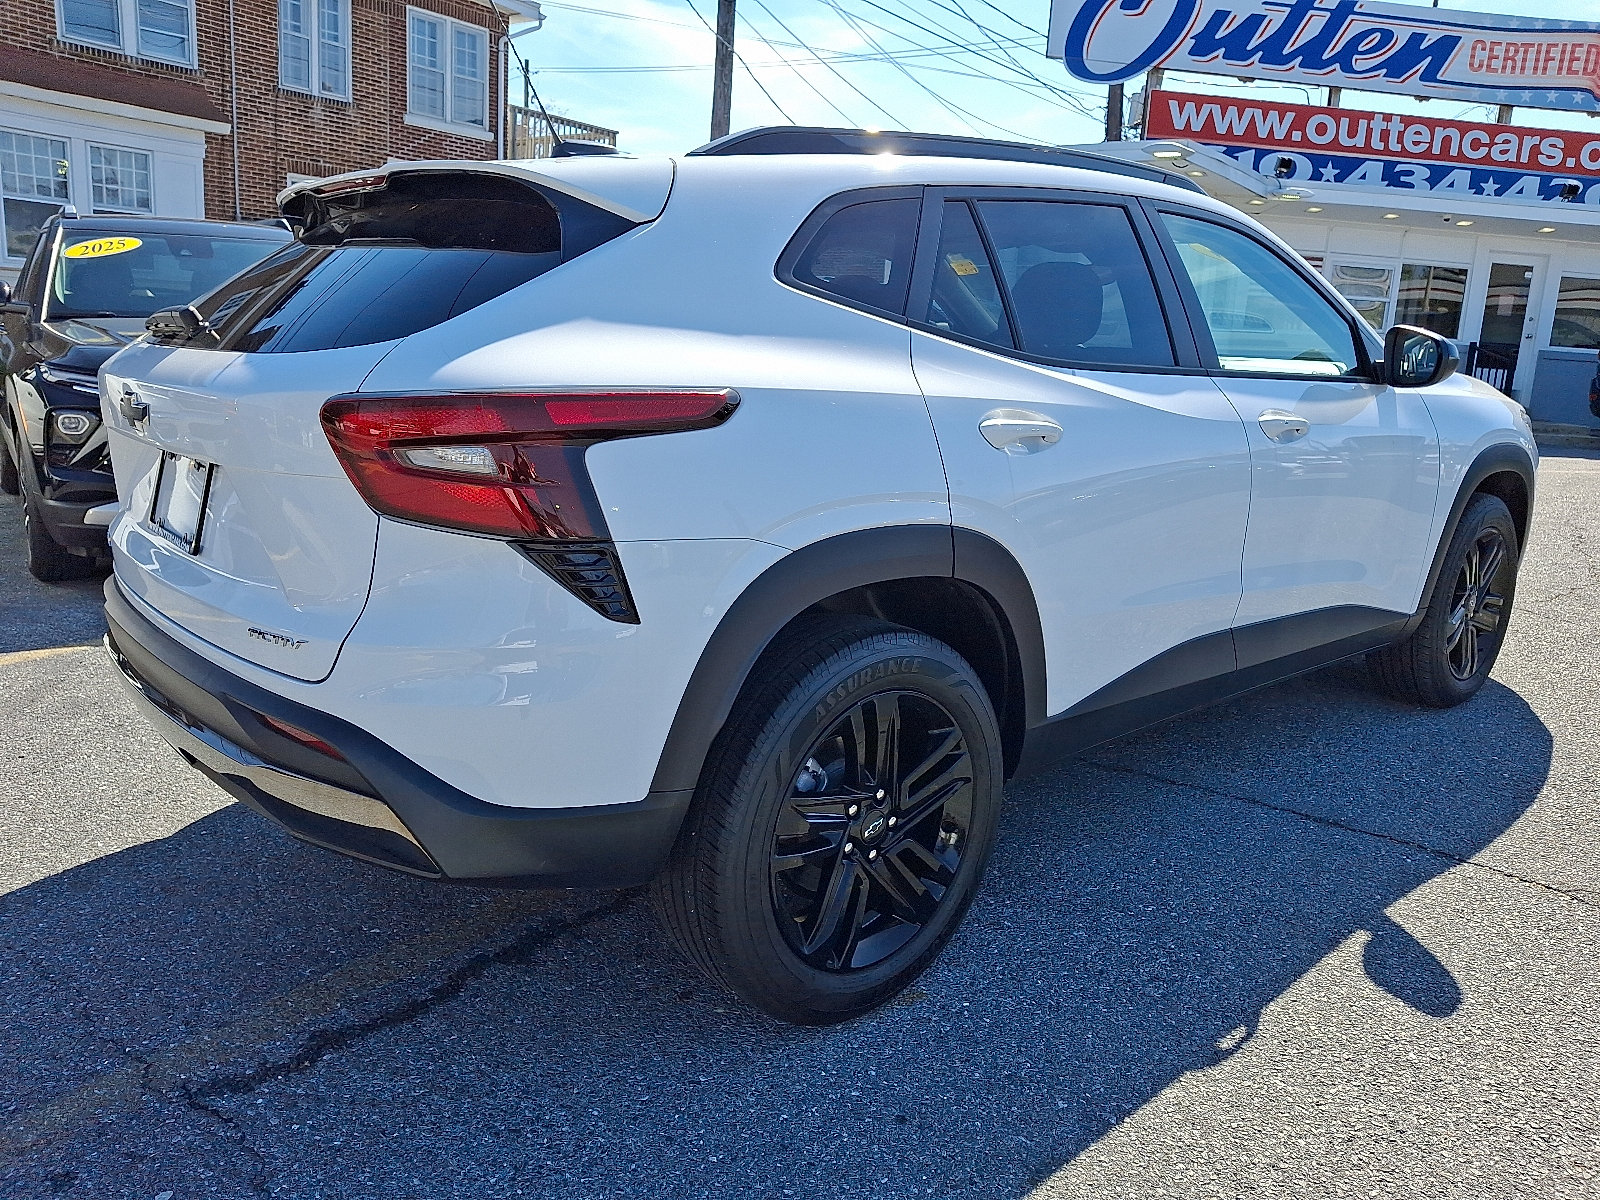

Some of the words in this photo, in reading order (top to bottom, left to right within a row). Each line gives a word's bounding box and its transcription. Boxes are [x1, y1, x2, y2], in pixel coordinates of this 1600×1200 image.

[1064, 0, 1463, 84] Outten
[1468, 39, 1600, 77] CERTIFIED
[79, 238, 126, 256] 2025
[815, 658, 923, 724] ASSURANCE
